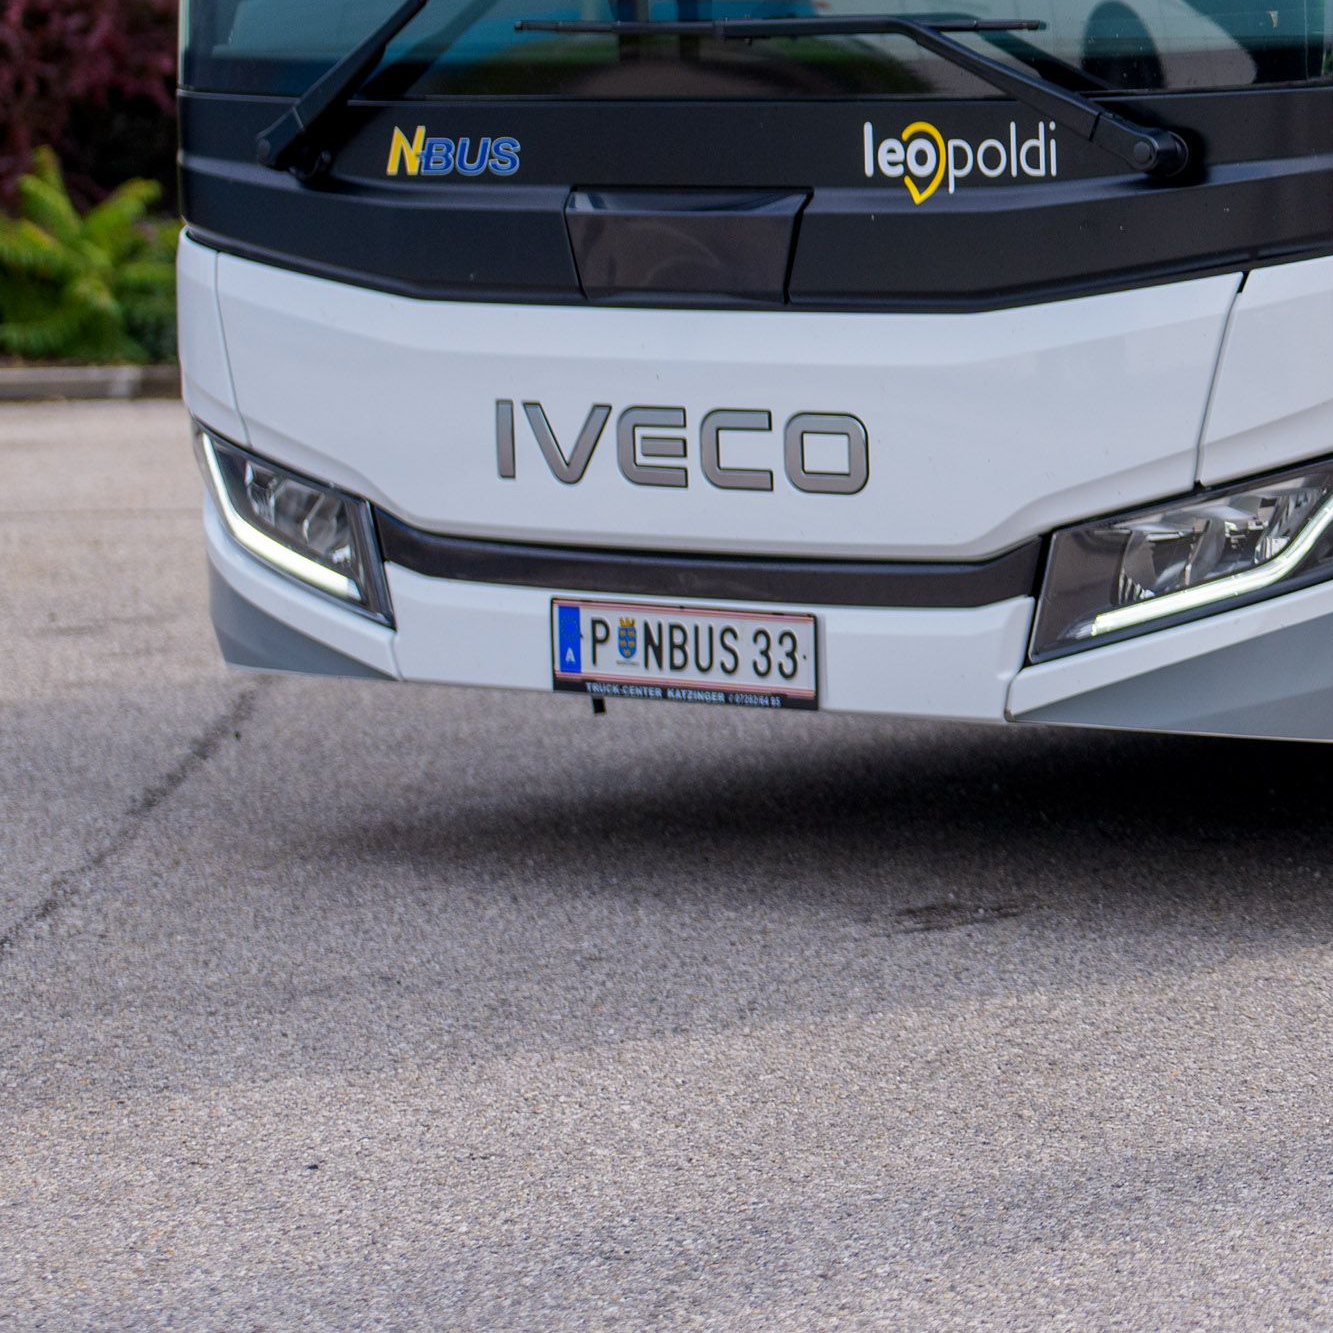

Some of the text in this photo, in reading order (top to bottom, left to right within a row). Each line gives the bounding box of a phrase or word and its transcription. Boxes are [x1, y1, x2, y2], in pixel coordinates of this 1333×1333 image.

[863, 121, 1057, 195] leopoldi
[493, 398, 870, 496] IVECO
[564, 647, 576, 665] A
[590, 618, 798, 680] P NBUS 33
[666, 687, 726, 703] KATZINGER
